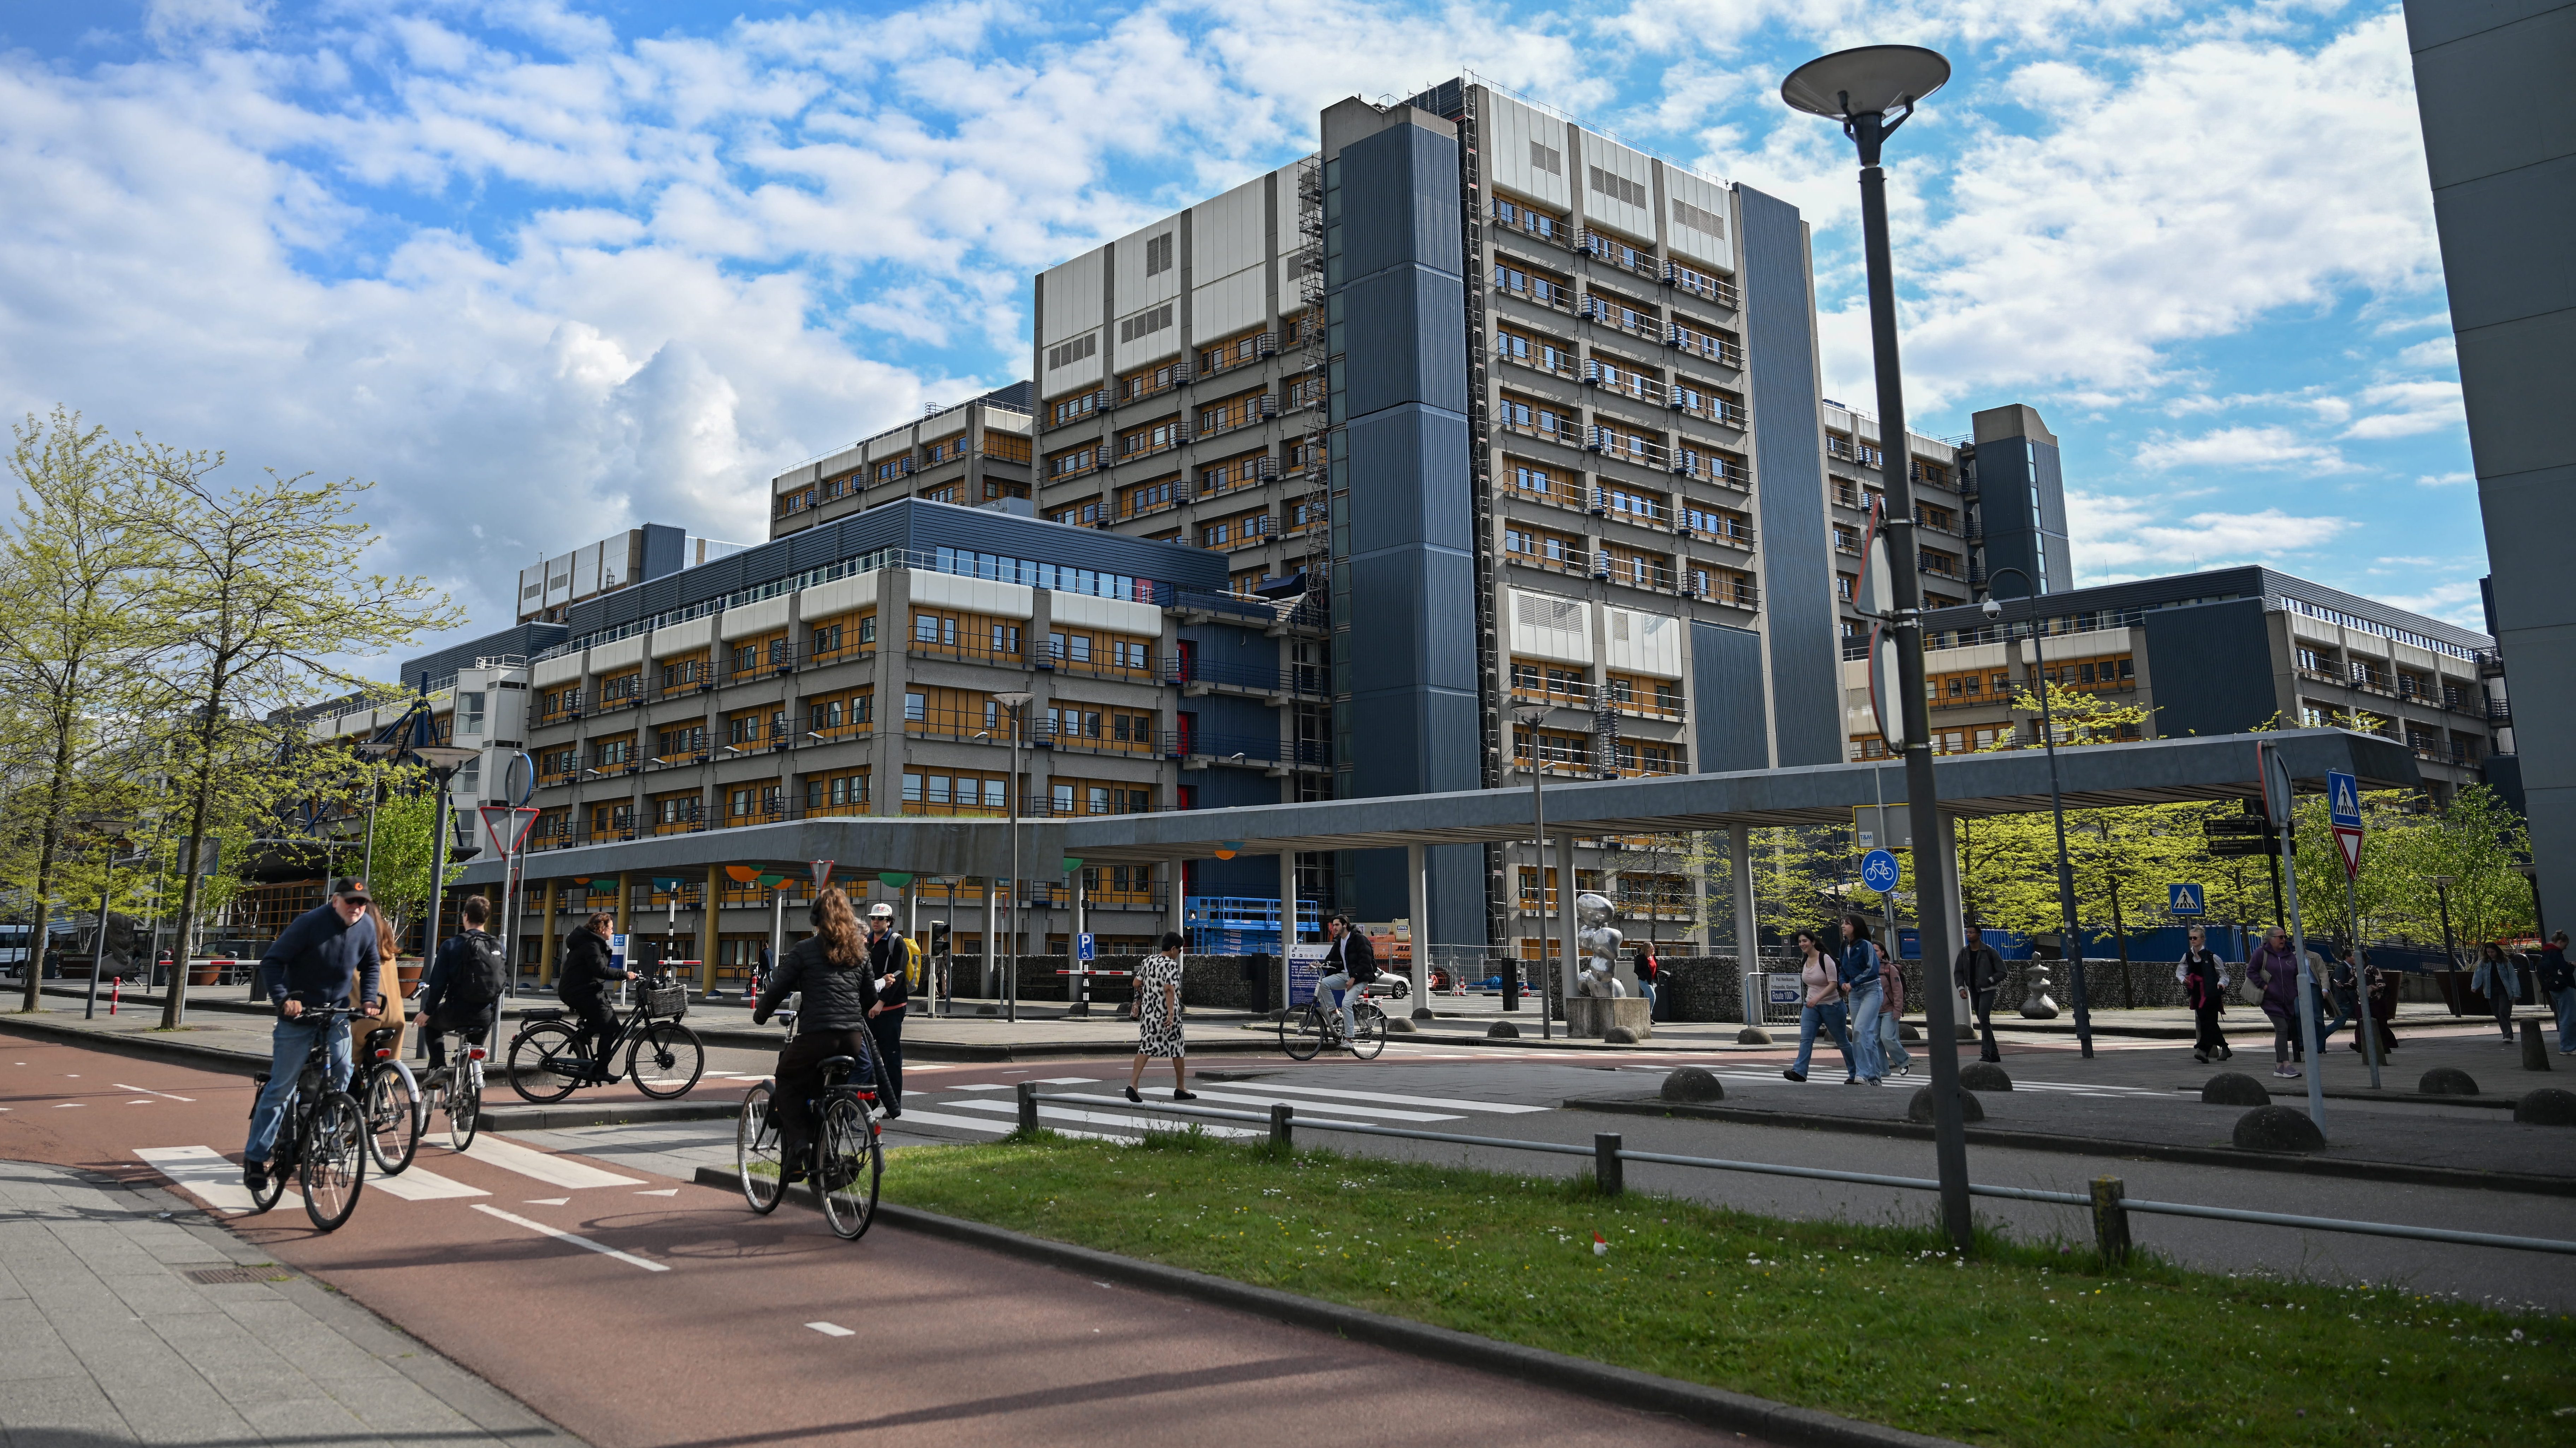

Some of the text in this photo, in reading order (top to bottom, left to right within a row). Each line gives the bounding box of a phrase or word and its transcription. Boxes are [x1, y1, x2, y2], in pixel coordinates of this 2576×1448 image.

[1082, 935, 1090, 948] P
[1772, 991, 1793, 1000] Route 1000
